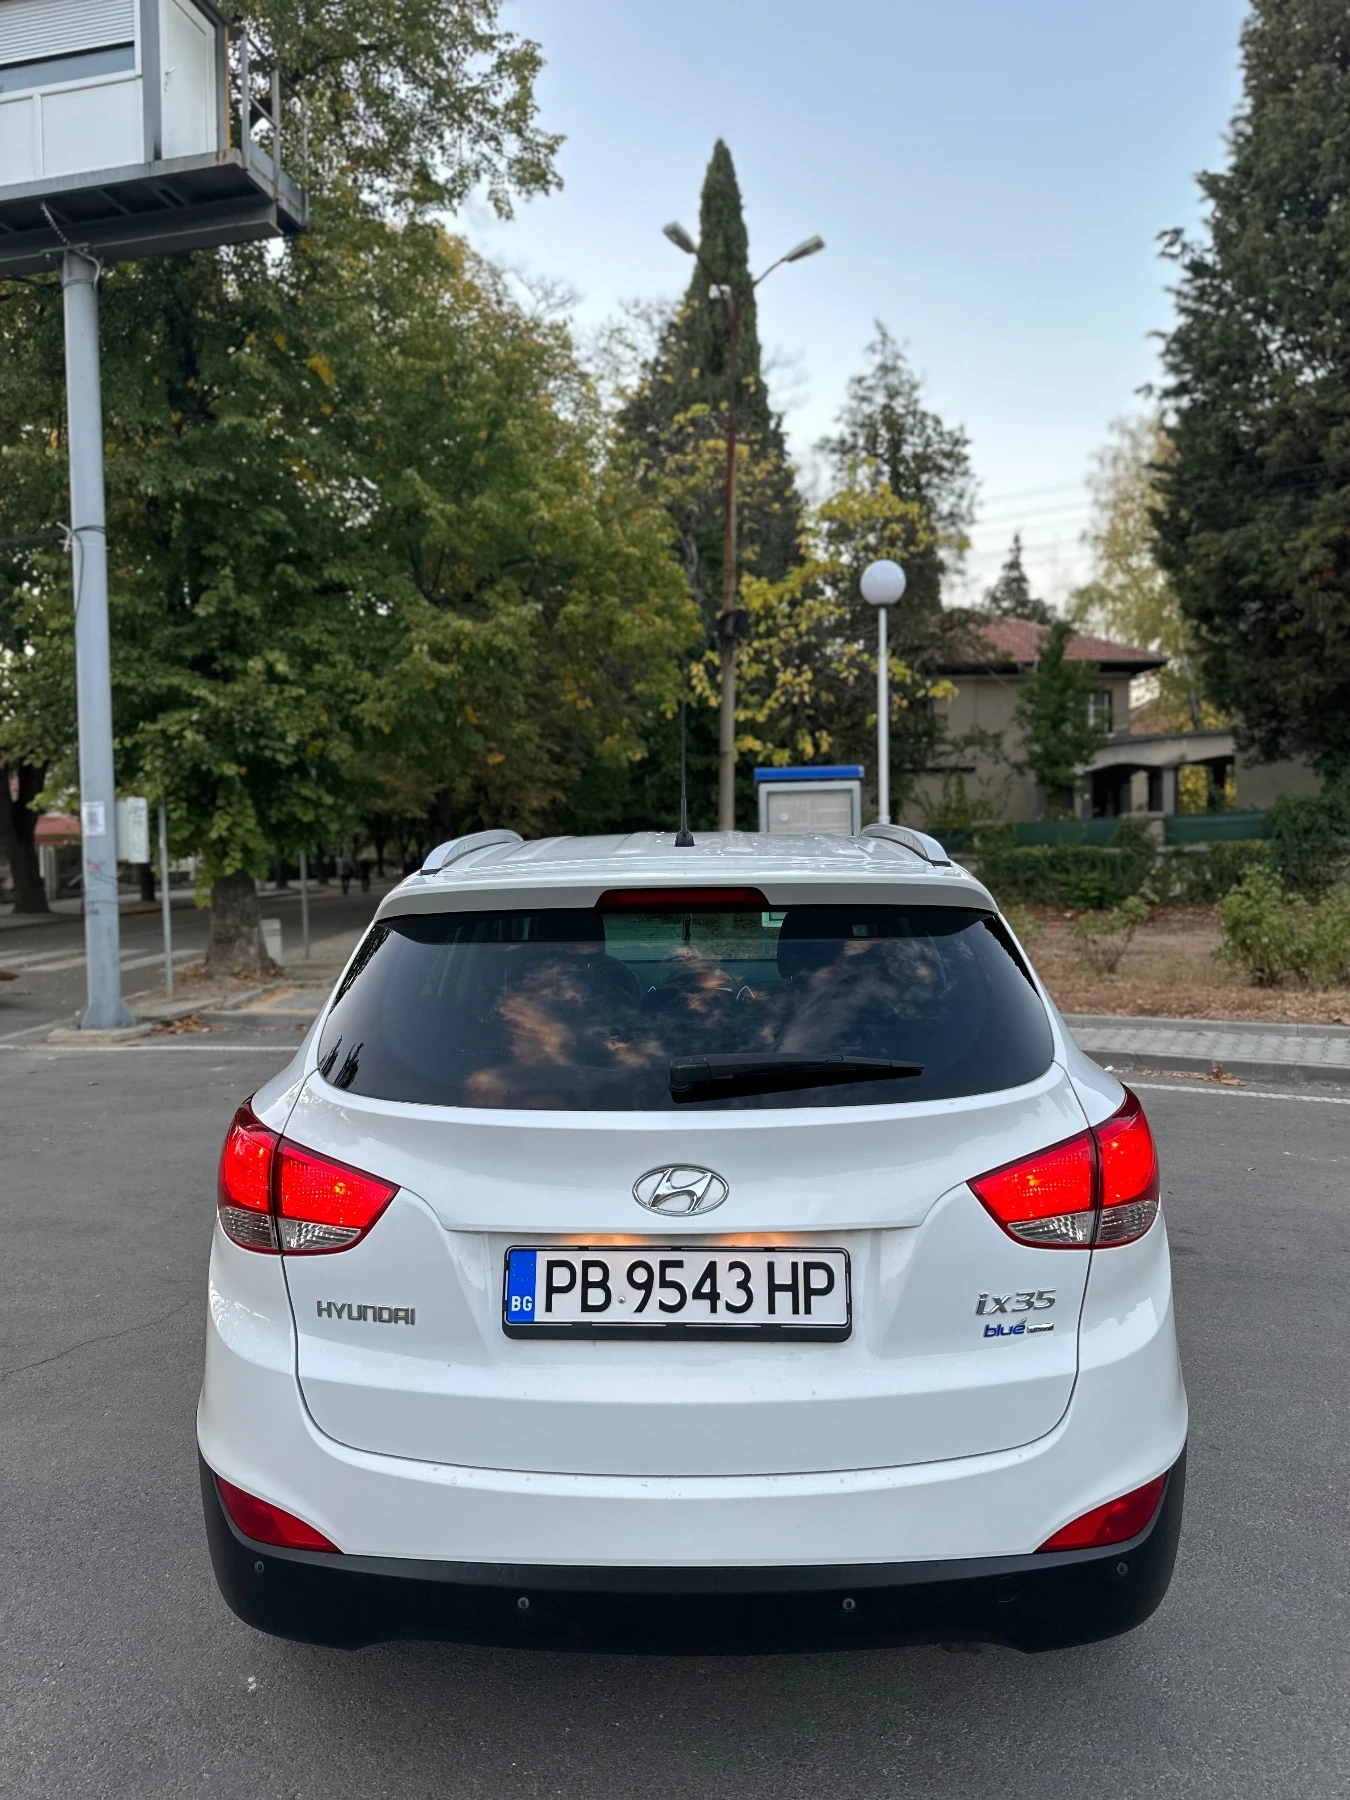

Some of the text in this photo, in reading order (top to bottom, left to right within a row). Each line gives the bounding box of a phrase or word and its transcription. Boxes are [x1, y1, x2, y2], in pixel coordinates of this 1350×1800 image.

[545, 1259, 835, 1316] PB 9543 HP
[316, 1300, 416, 1326] HYUNDAI
[510, 1295, 533, 1313] BG
[975, 1287, 1057, 1316] ix35
[983, 1323, 1026, 1338] blue
